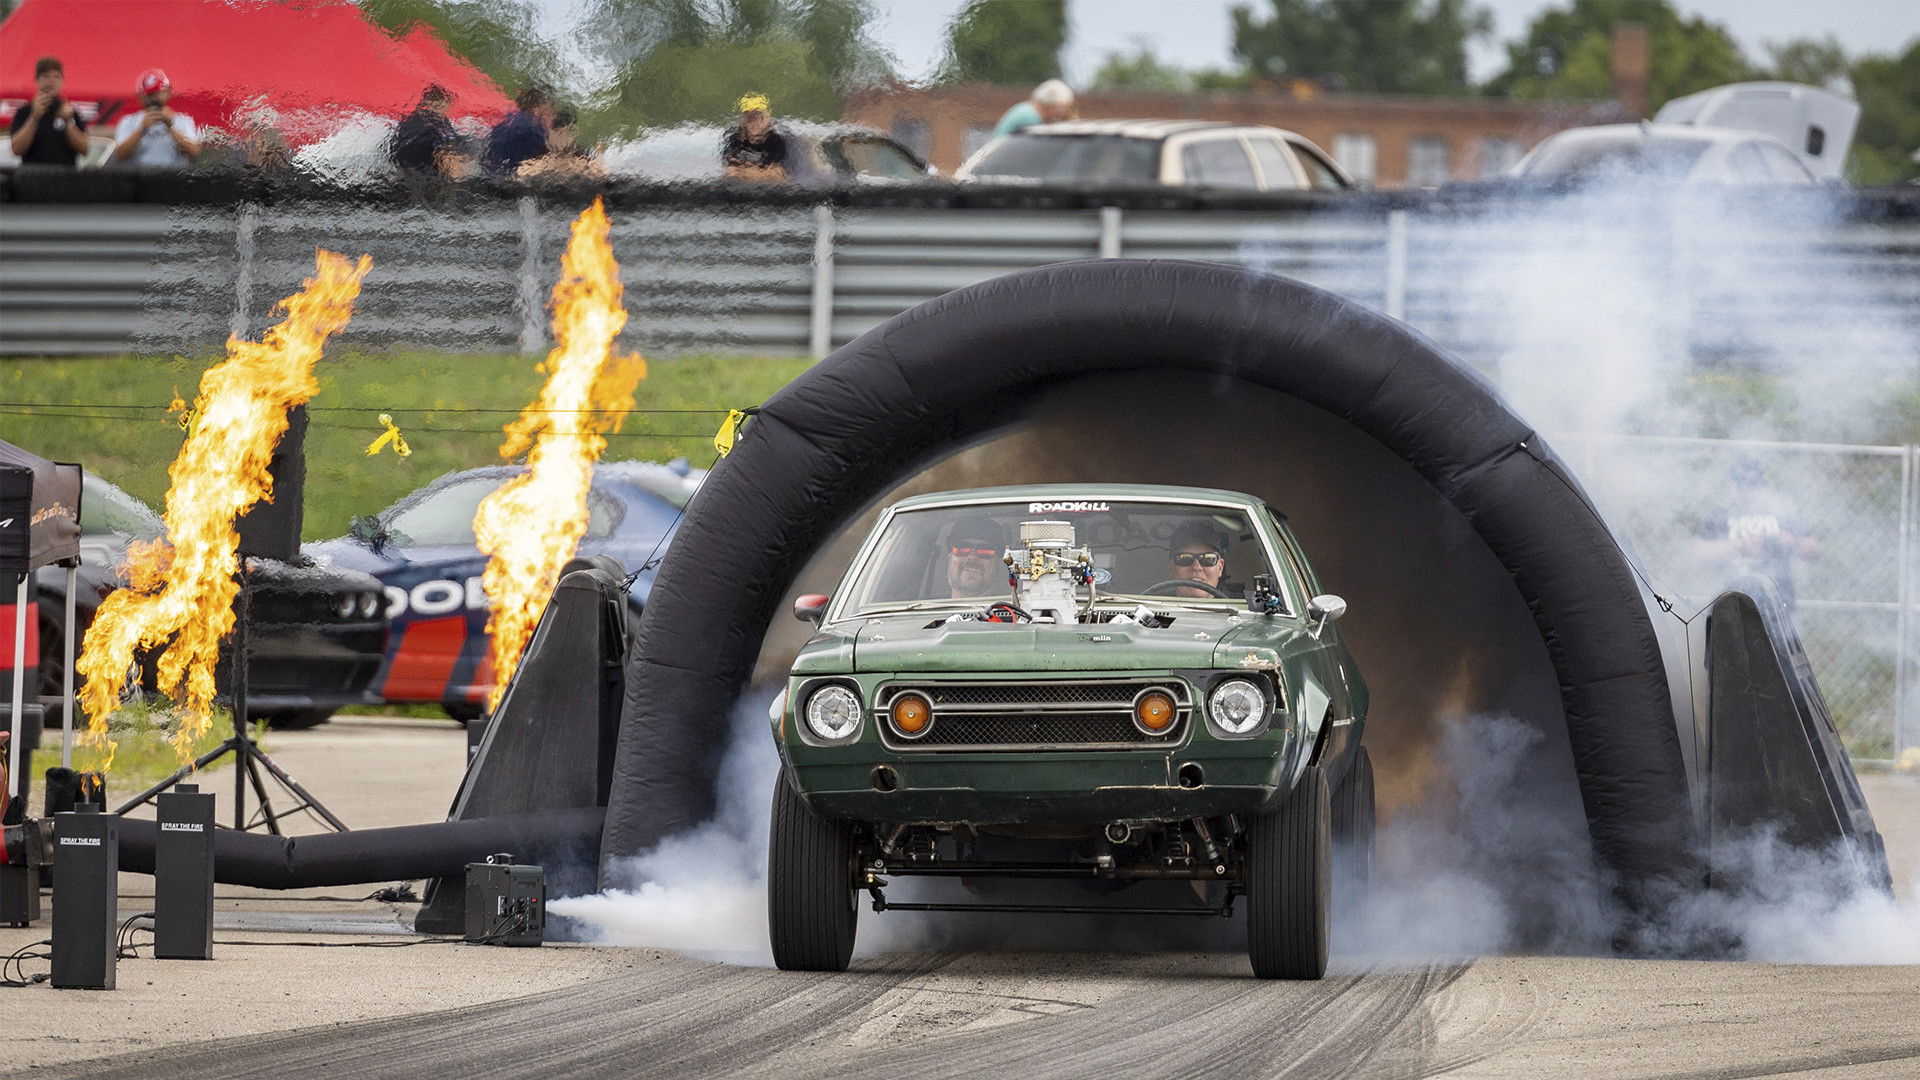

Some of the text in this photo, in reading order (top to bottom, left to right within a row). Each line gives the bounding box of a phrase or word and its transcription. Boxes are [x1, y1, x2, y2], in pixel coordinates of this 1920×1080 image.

[1028, 502, 1110, 514] ROADKILL
[161, 822, 180, 830] SPRAY
[190, 823, 204, 831] FIRE
